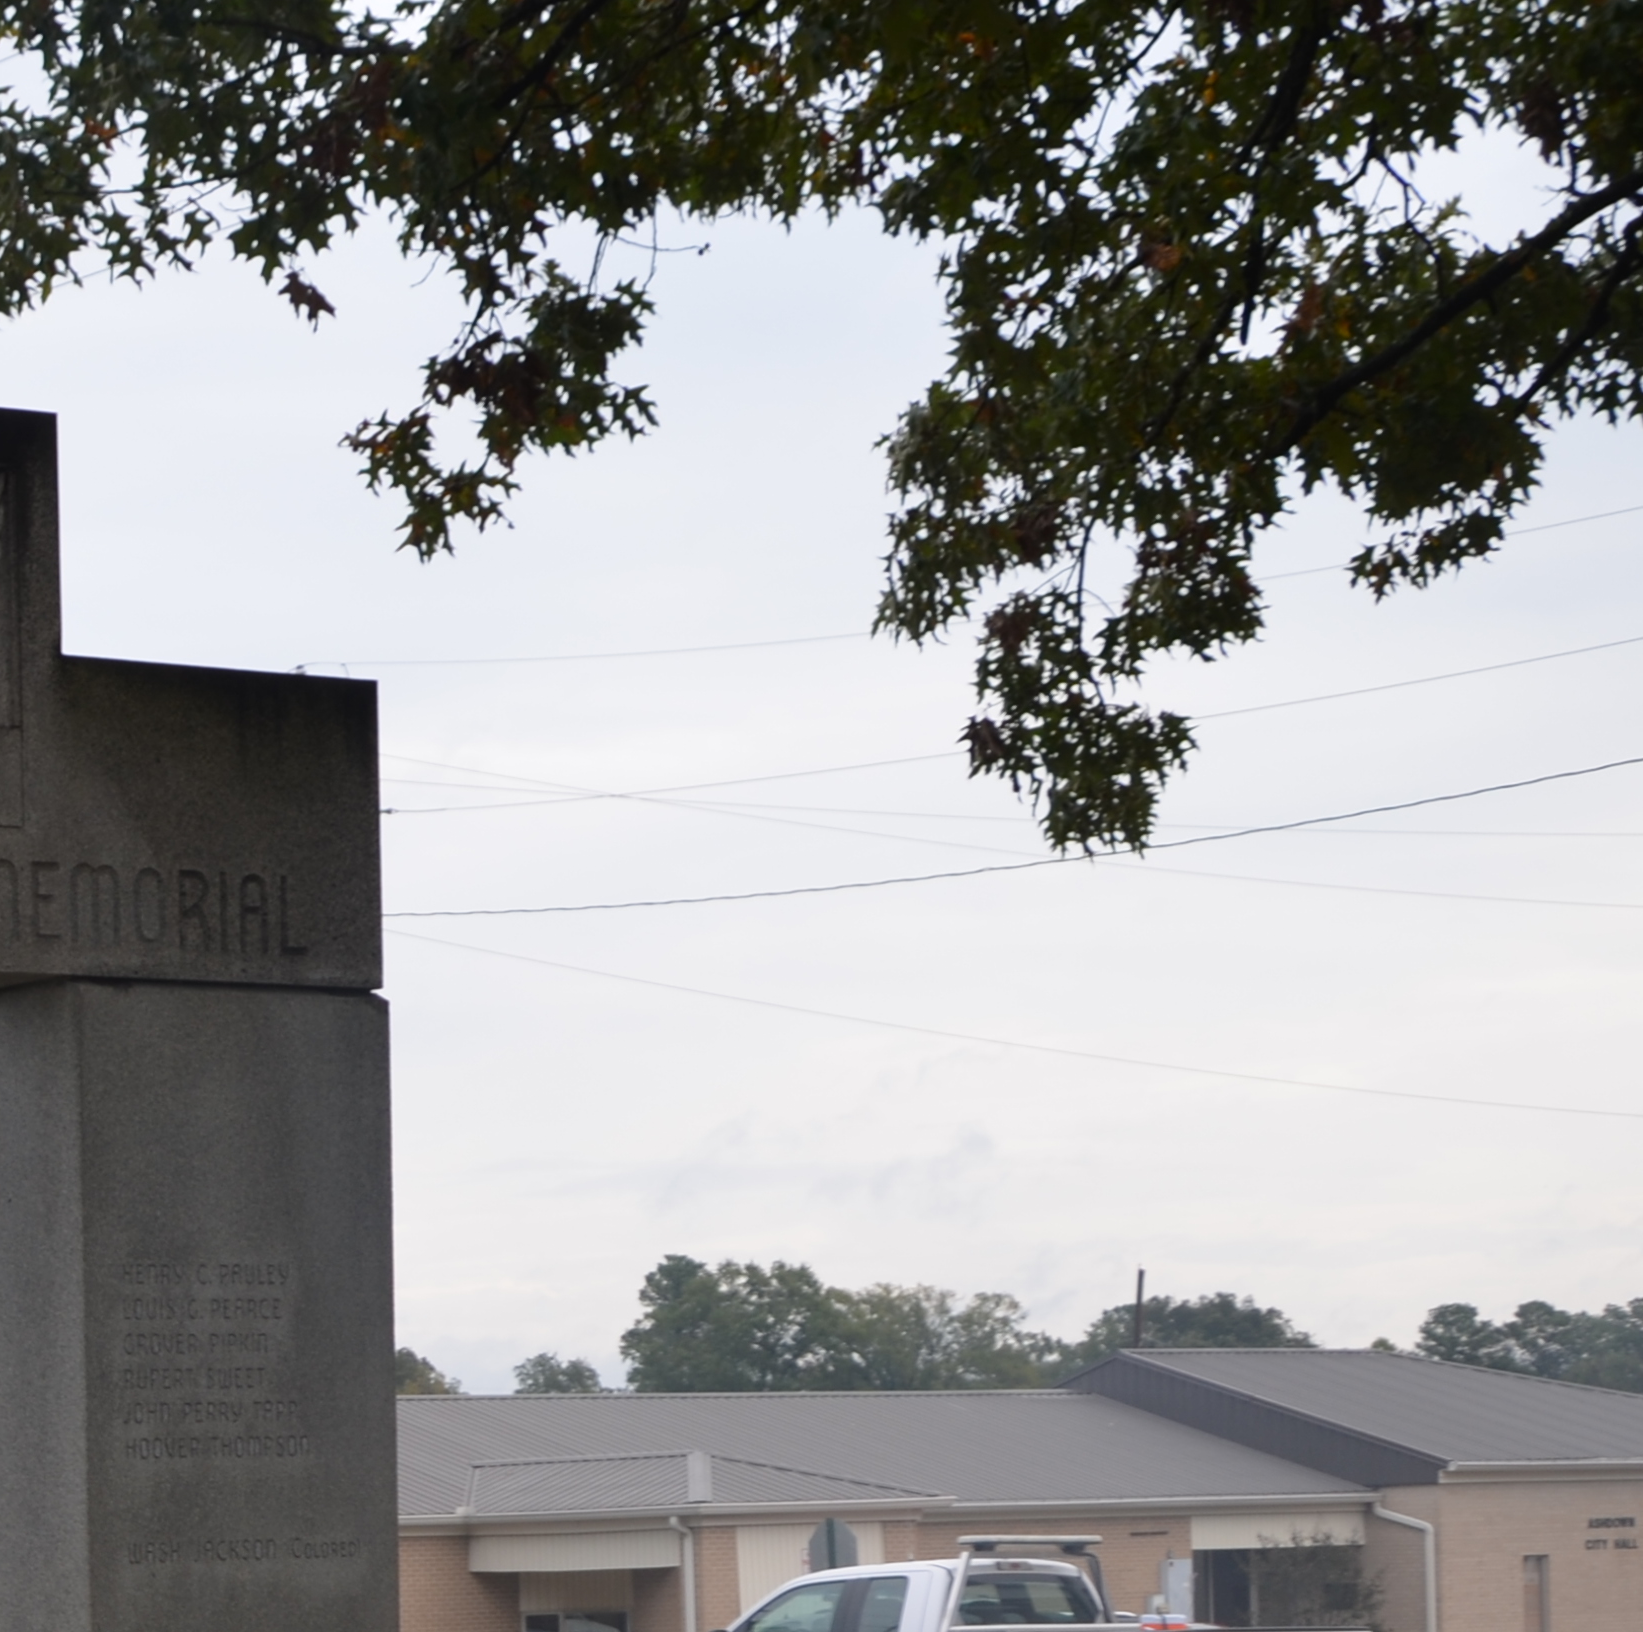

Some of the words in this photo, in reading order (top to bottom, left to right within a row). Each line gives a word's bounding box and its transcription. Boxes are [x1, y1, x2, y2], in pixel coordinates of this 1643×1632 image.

[122, 1262, 184, 1286] HENRY
[218, 1261, 291, 1287] PAULEY
[122, 1297, 176, 1322] LOUIS
[210, 1296, 283, 1321] PEARCE
[122, 1332, 199, 1357] GROVER
[208, 1332, 269, 1355] PIPKIN
[205, 1366, 266, 1390] SWEET
[123, 1401, 172, 1425] JOHN
[182, 1400, 244, 1424] PERRY
[125, 1435, 202, 1460] HOOVER
[210, 1433, 311, 1459] THOMPSON
[128, 1540, 182, 1566] WASH
[193, 1537, 277, 1563] JACKSON
